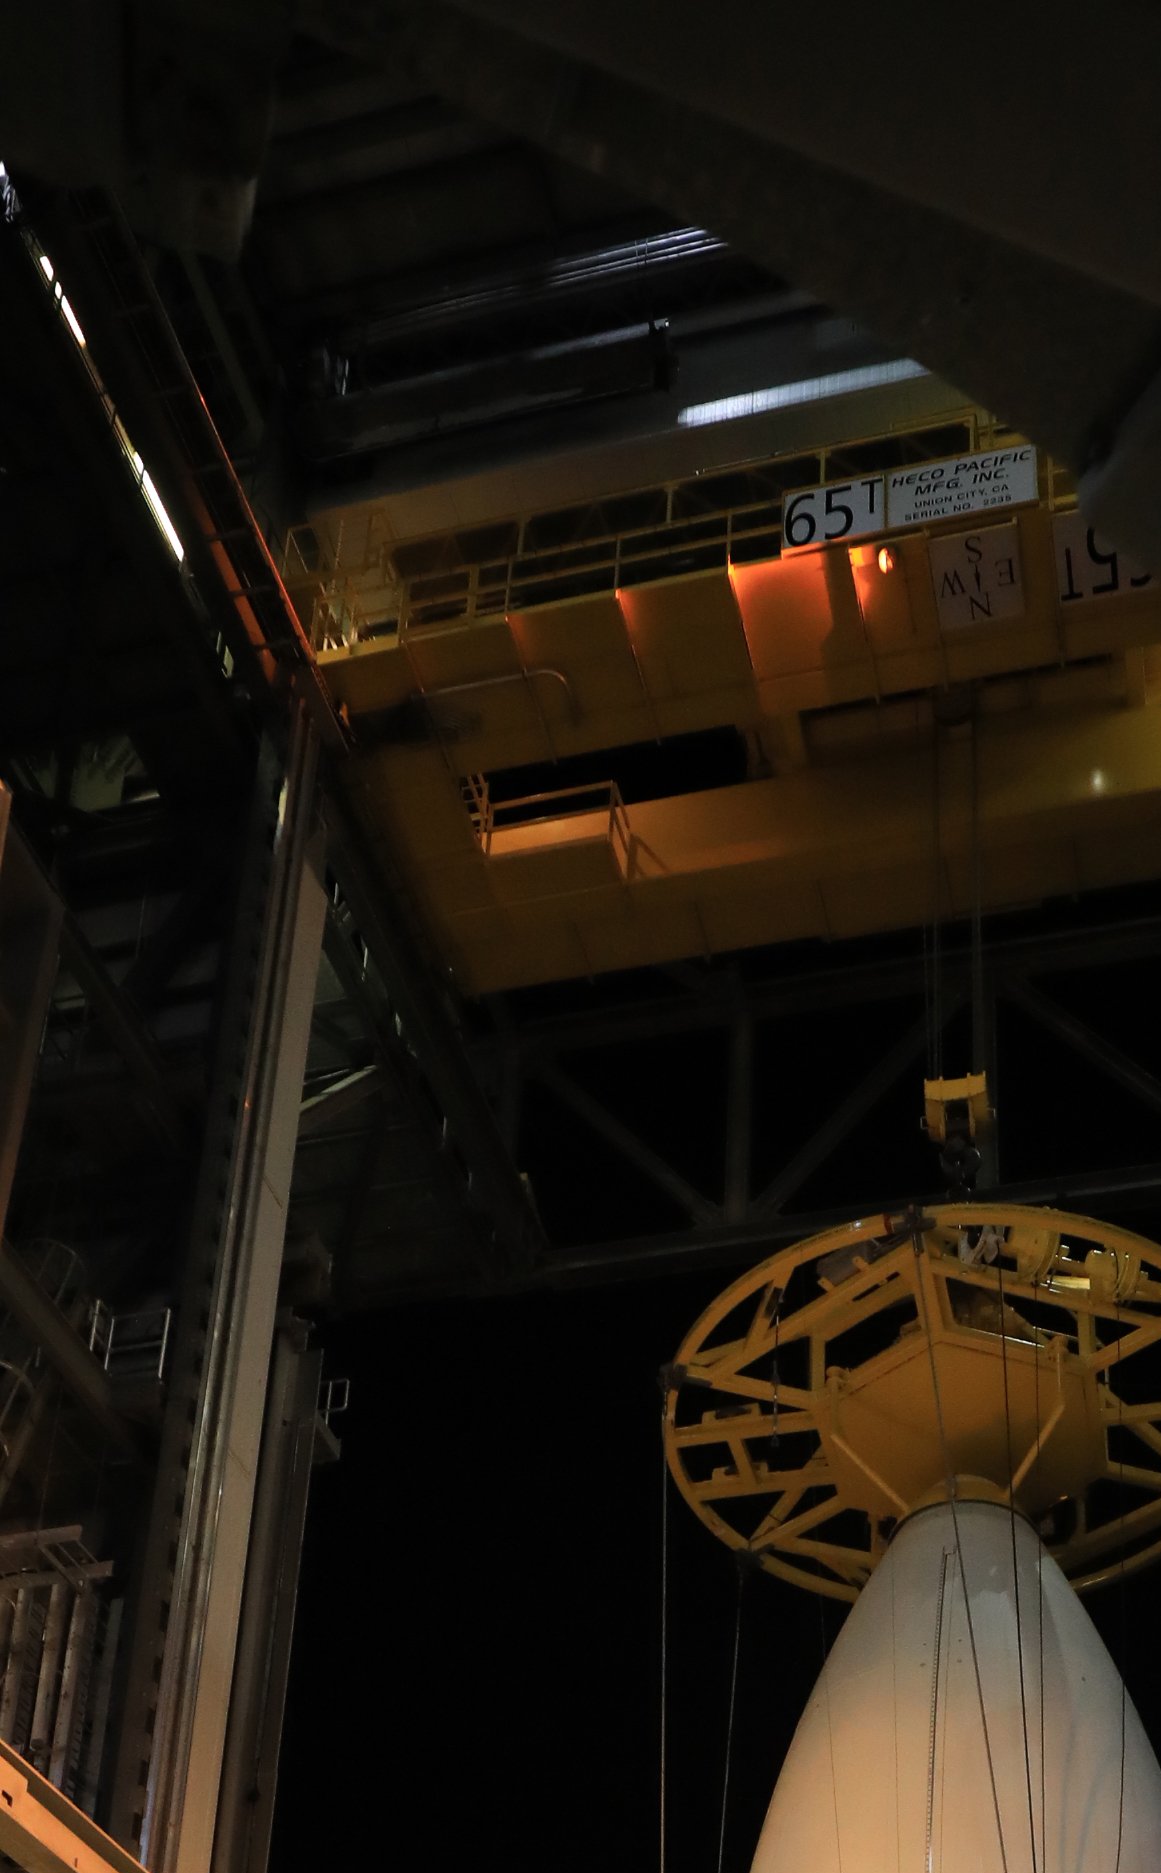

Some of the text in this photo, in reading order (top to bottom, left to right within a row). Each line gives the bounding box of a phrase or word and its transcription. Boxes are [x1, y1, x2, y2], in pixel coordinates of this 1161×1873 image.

[892, 449, 1033, 488] HECO PACIFIC
[914, 467, 1011, 497] MFG. INC.
[914, 494, 953, 509] UNION
[991, 483, 1009, 493] CA
[784, 477, 885, 547] 65T
[904, 508, 947, 522] SERIAL
[953, 501, 975, 513] NO.
[964, 535, 983, 564] S
[1060, 525, 1153, 602] 5T
[994, 557, 1016, 587] E
[968, 591, 993, 621] N
